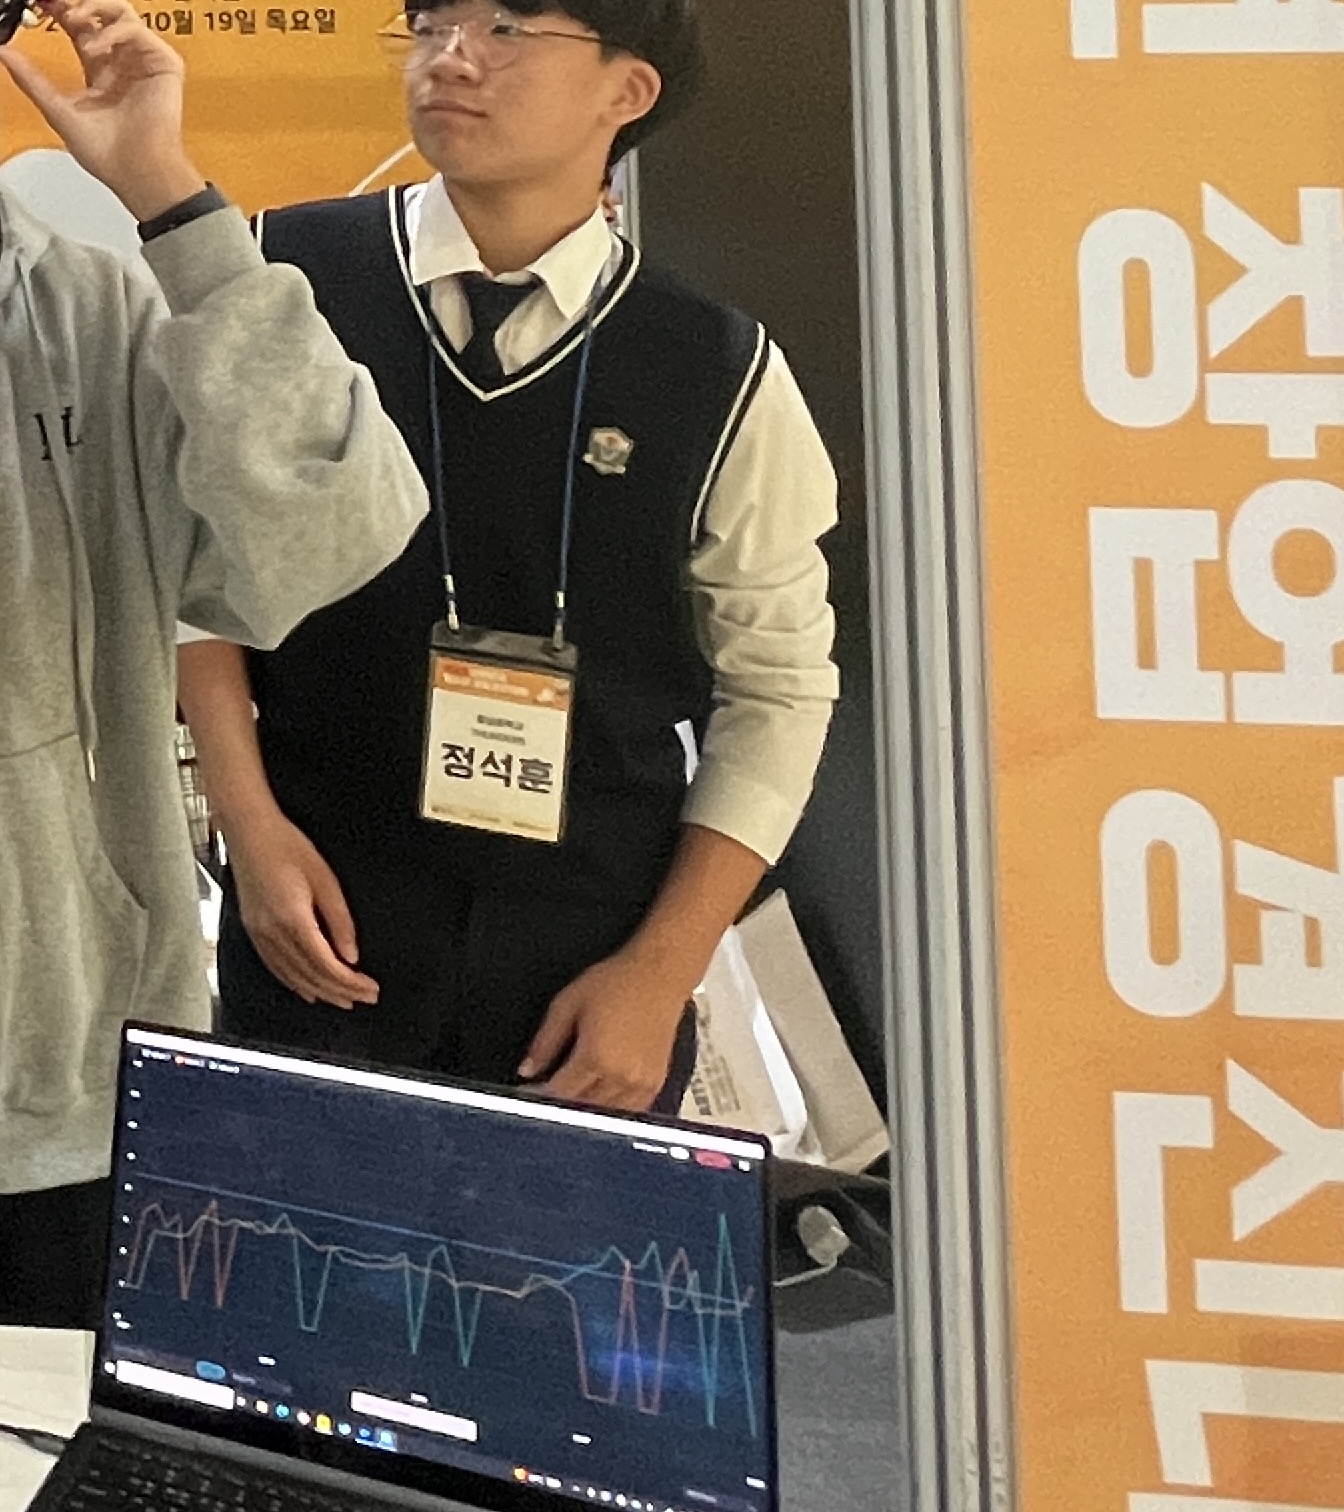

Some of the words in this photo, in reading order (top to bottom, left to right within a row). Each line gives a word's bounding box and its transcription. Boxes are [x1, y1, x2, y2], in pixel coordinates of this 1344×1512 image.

[141, 8, 194, 35] 10월
[204, 9, 256, 34] 19일
[266, 8, 337, 34] 목요일
[440, 742, 554, 794] 정석훈
